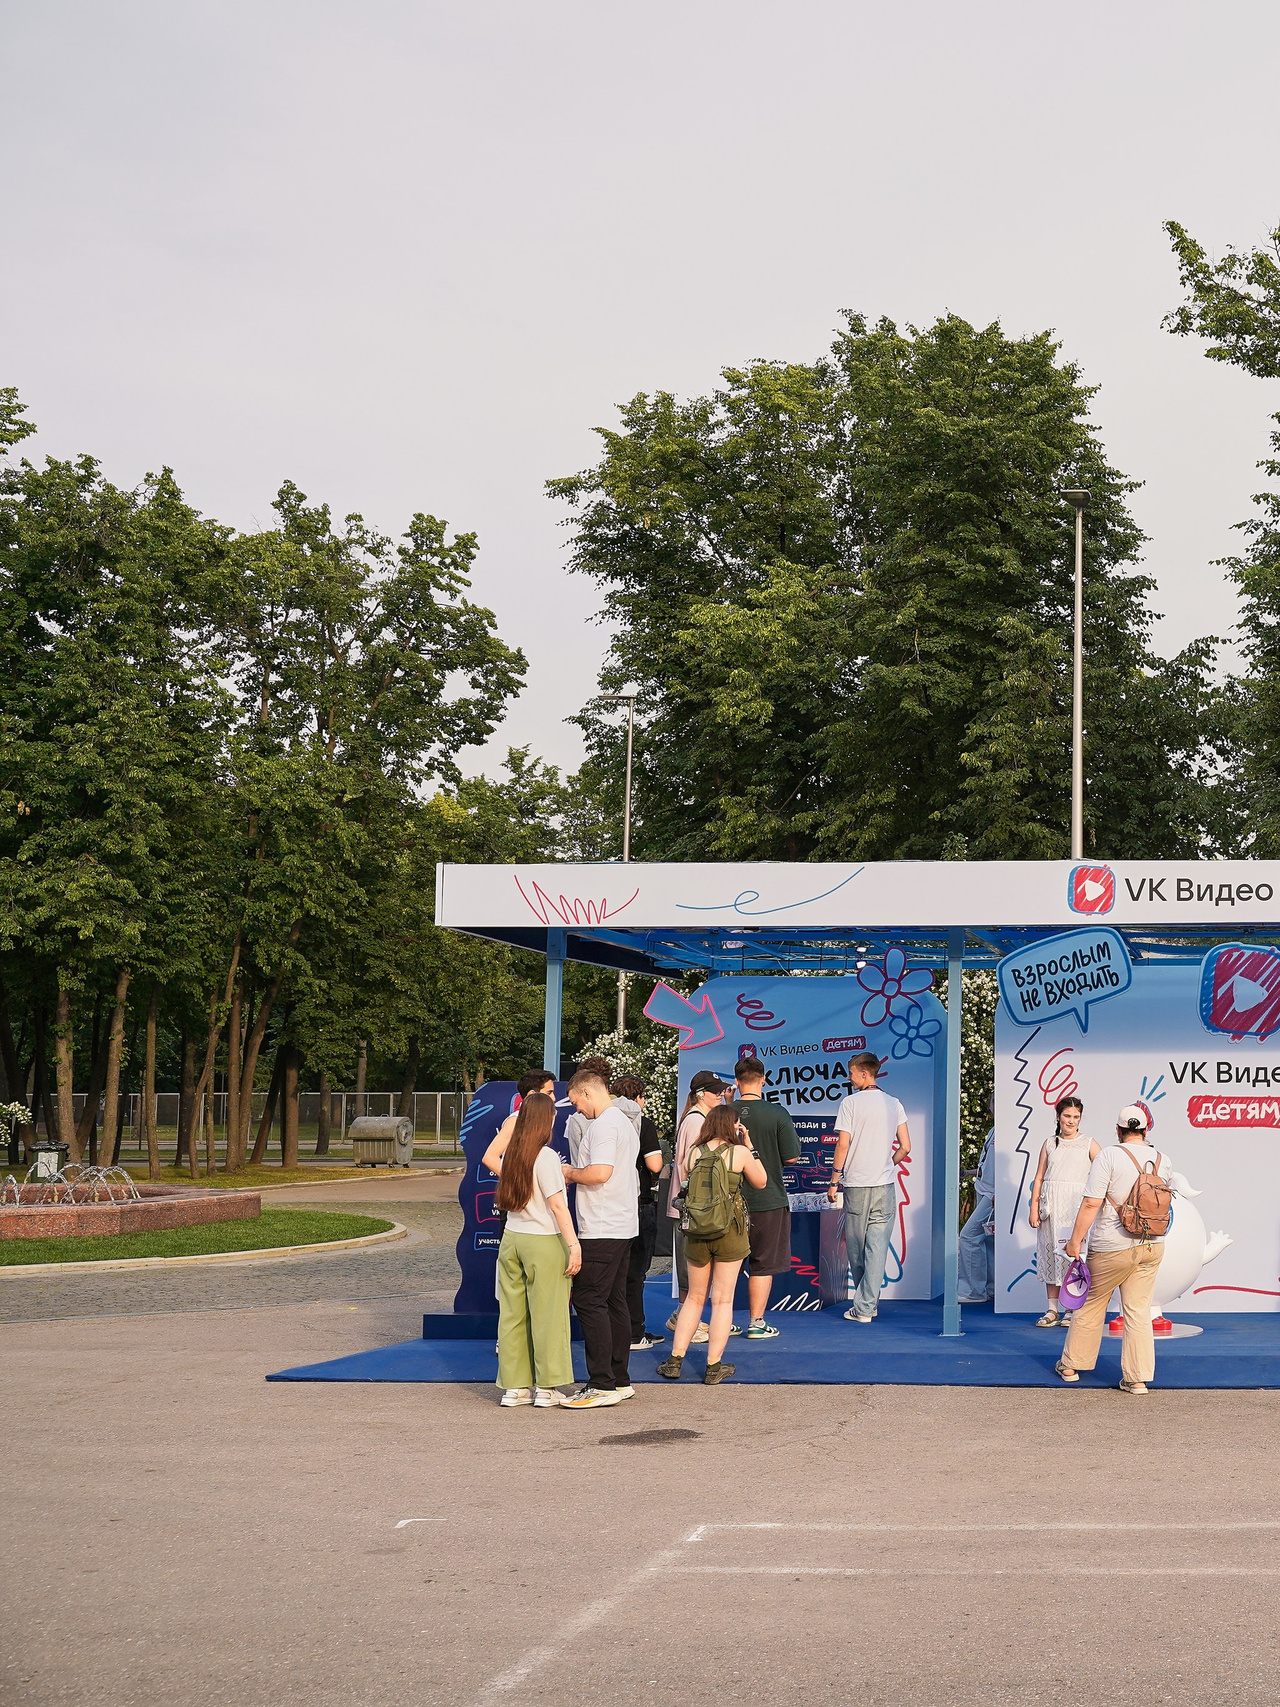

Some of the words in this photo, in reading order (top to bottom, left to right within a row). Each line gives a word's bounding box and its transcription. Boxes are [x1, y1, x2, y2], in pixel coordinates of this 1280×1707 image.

[1125, 878, 1167, 902] VK
[1176, 878, 1274, 906] Видео
[1011, 941, 1111, 988] ВЗРОСЛЫМ
[1043, 964, 1120, 1006] ВХОДИТЬ
[760, 1045, 777, 1057] VK
[780, 1043, 819, 1056] Видео
[826, 1036, 863, 1050] детям
[1169, 1062, 1208, 1083] VK
[761, 1081, 853, 1106] ЕТКОСТ
[1197, 1102, 1280, 1126] детям
